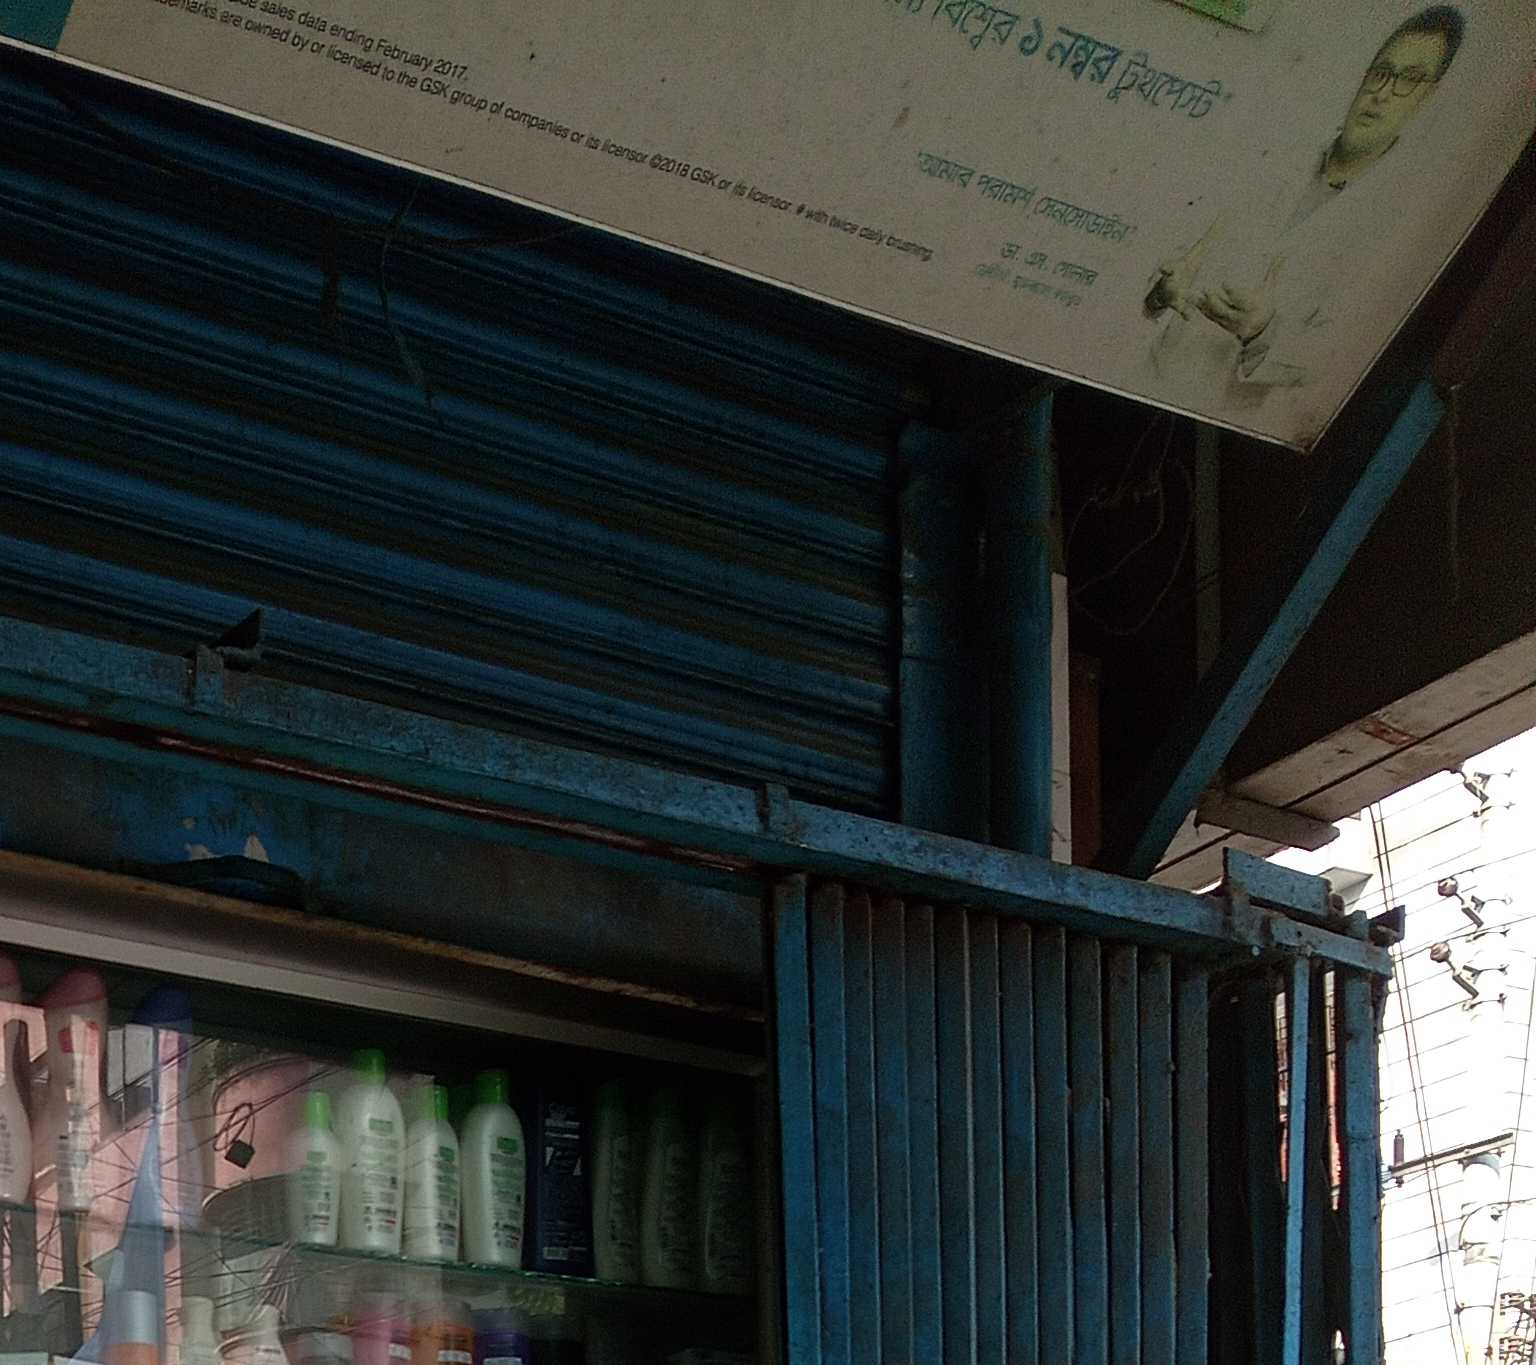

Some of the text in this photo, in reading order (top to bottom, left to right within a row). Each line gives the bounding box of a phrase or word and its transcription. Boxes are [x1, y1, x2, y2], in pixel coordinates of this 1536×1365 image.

[297, 13, 327, 32] data
[330, 23, 375, 52] ending
[376, 38, 433, 72] February
[244, 19, 289, 44] owned
[291, 30, 309, 51] by
[310, 41, 325, 56] or
[325, 45, 381, 78] licensed
[381, 66, 395, 82] to
[396, 69, 418, 90] the
[419, 77, 450, 99] GSK
[450, 88, 488, 115] group
[489, 101, 505, 117] of
[504, 106, 569, 139] companies
[570, 131, 585, 143] or
[691, 168, 718, 188] GSK
[718, 179, 733, 190] or
[805, 207, 828, 225] with
